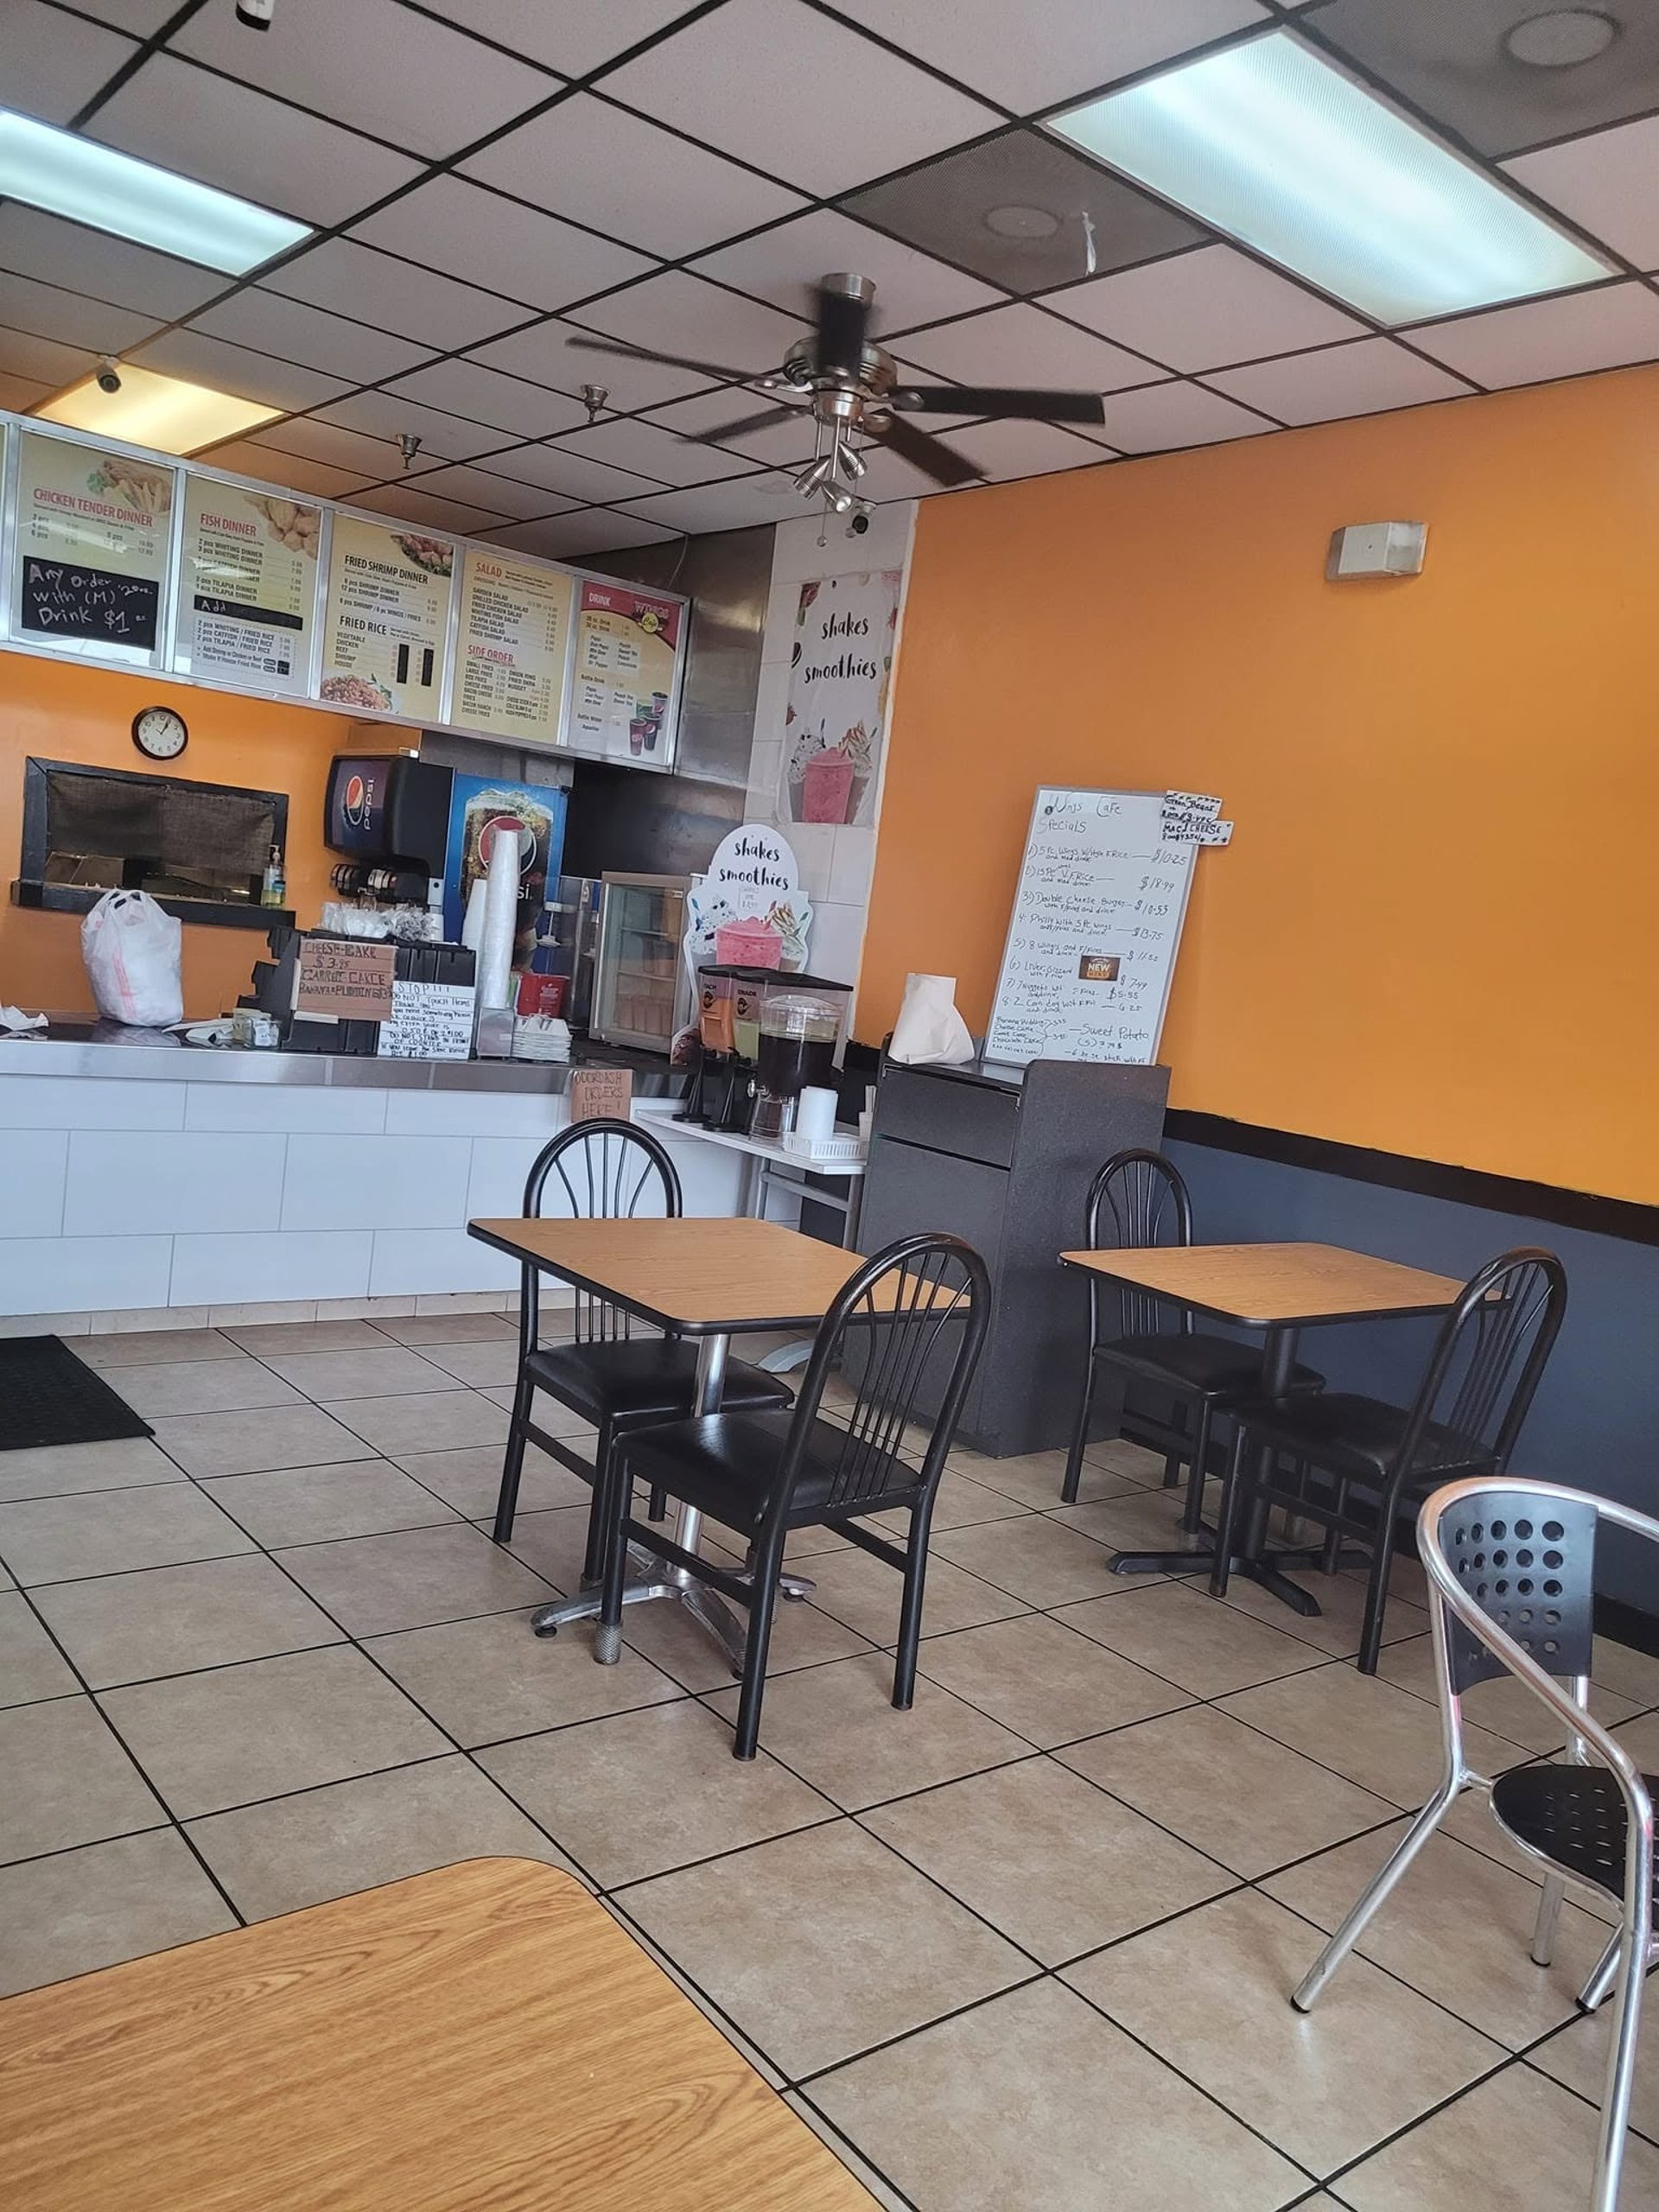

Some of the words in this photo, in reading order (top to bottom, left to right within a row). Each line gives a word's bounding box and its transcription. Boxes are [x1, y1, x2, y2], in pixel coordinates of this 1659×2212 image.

[34, 488, 76, 509] CHICKEN
[78, 499, 116, 519] TENDER
[117, 507, 154, 528] DINNER
[200, 513, 222, 528] FISH
[222, 518, 258, 537] DINNER
[345, 554, 367, 570] FRIED
[367, 561, 399, 578] SHRIMP
[399, 569, 429, 585] DINNER
[476, 563, 502, 578] SALAD
[201, 600, 226, 613] Add
[588, 592, 612, 607] DRINK
[38, 606, 93, 626] Drink
[340, 615, 366, 632] FRIED
[367, 621, 388, 636] RICE
[821, 611, 869, 639] shakes
[467, 645, 486, 657] SIDE
[486, 649, 515, 664] ORDER
[804, 653, 878, 684] smoothies
[363, 779, 374, 830] pepsi
[734, 837, 780, 861] shakes
[719, 866, 789, 891] smoothies
[1035, 891, 1063, 906] Double
[1088, 963, 1111, 972] NEW
[1079, 1023, 1115, 1037] Sweet
[1118, 1026, 1150, 1041] Potato
